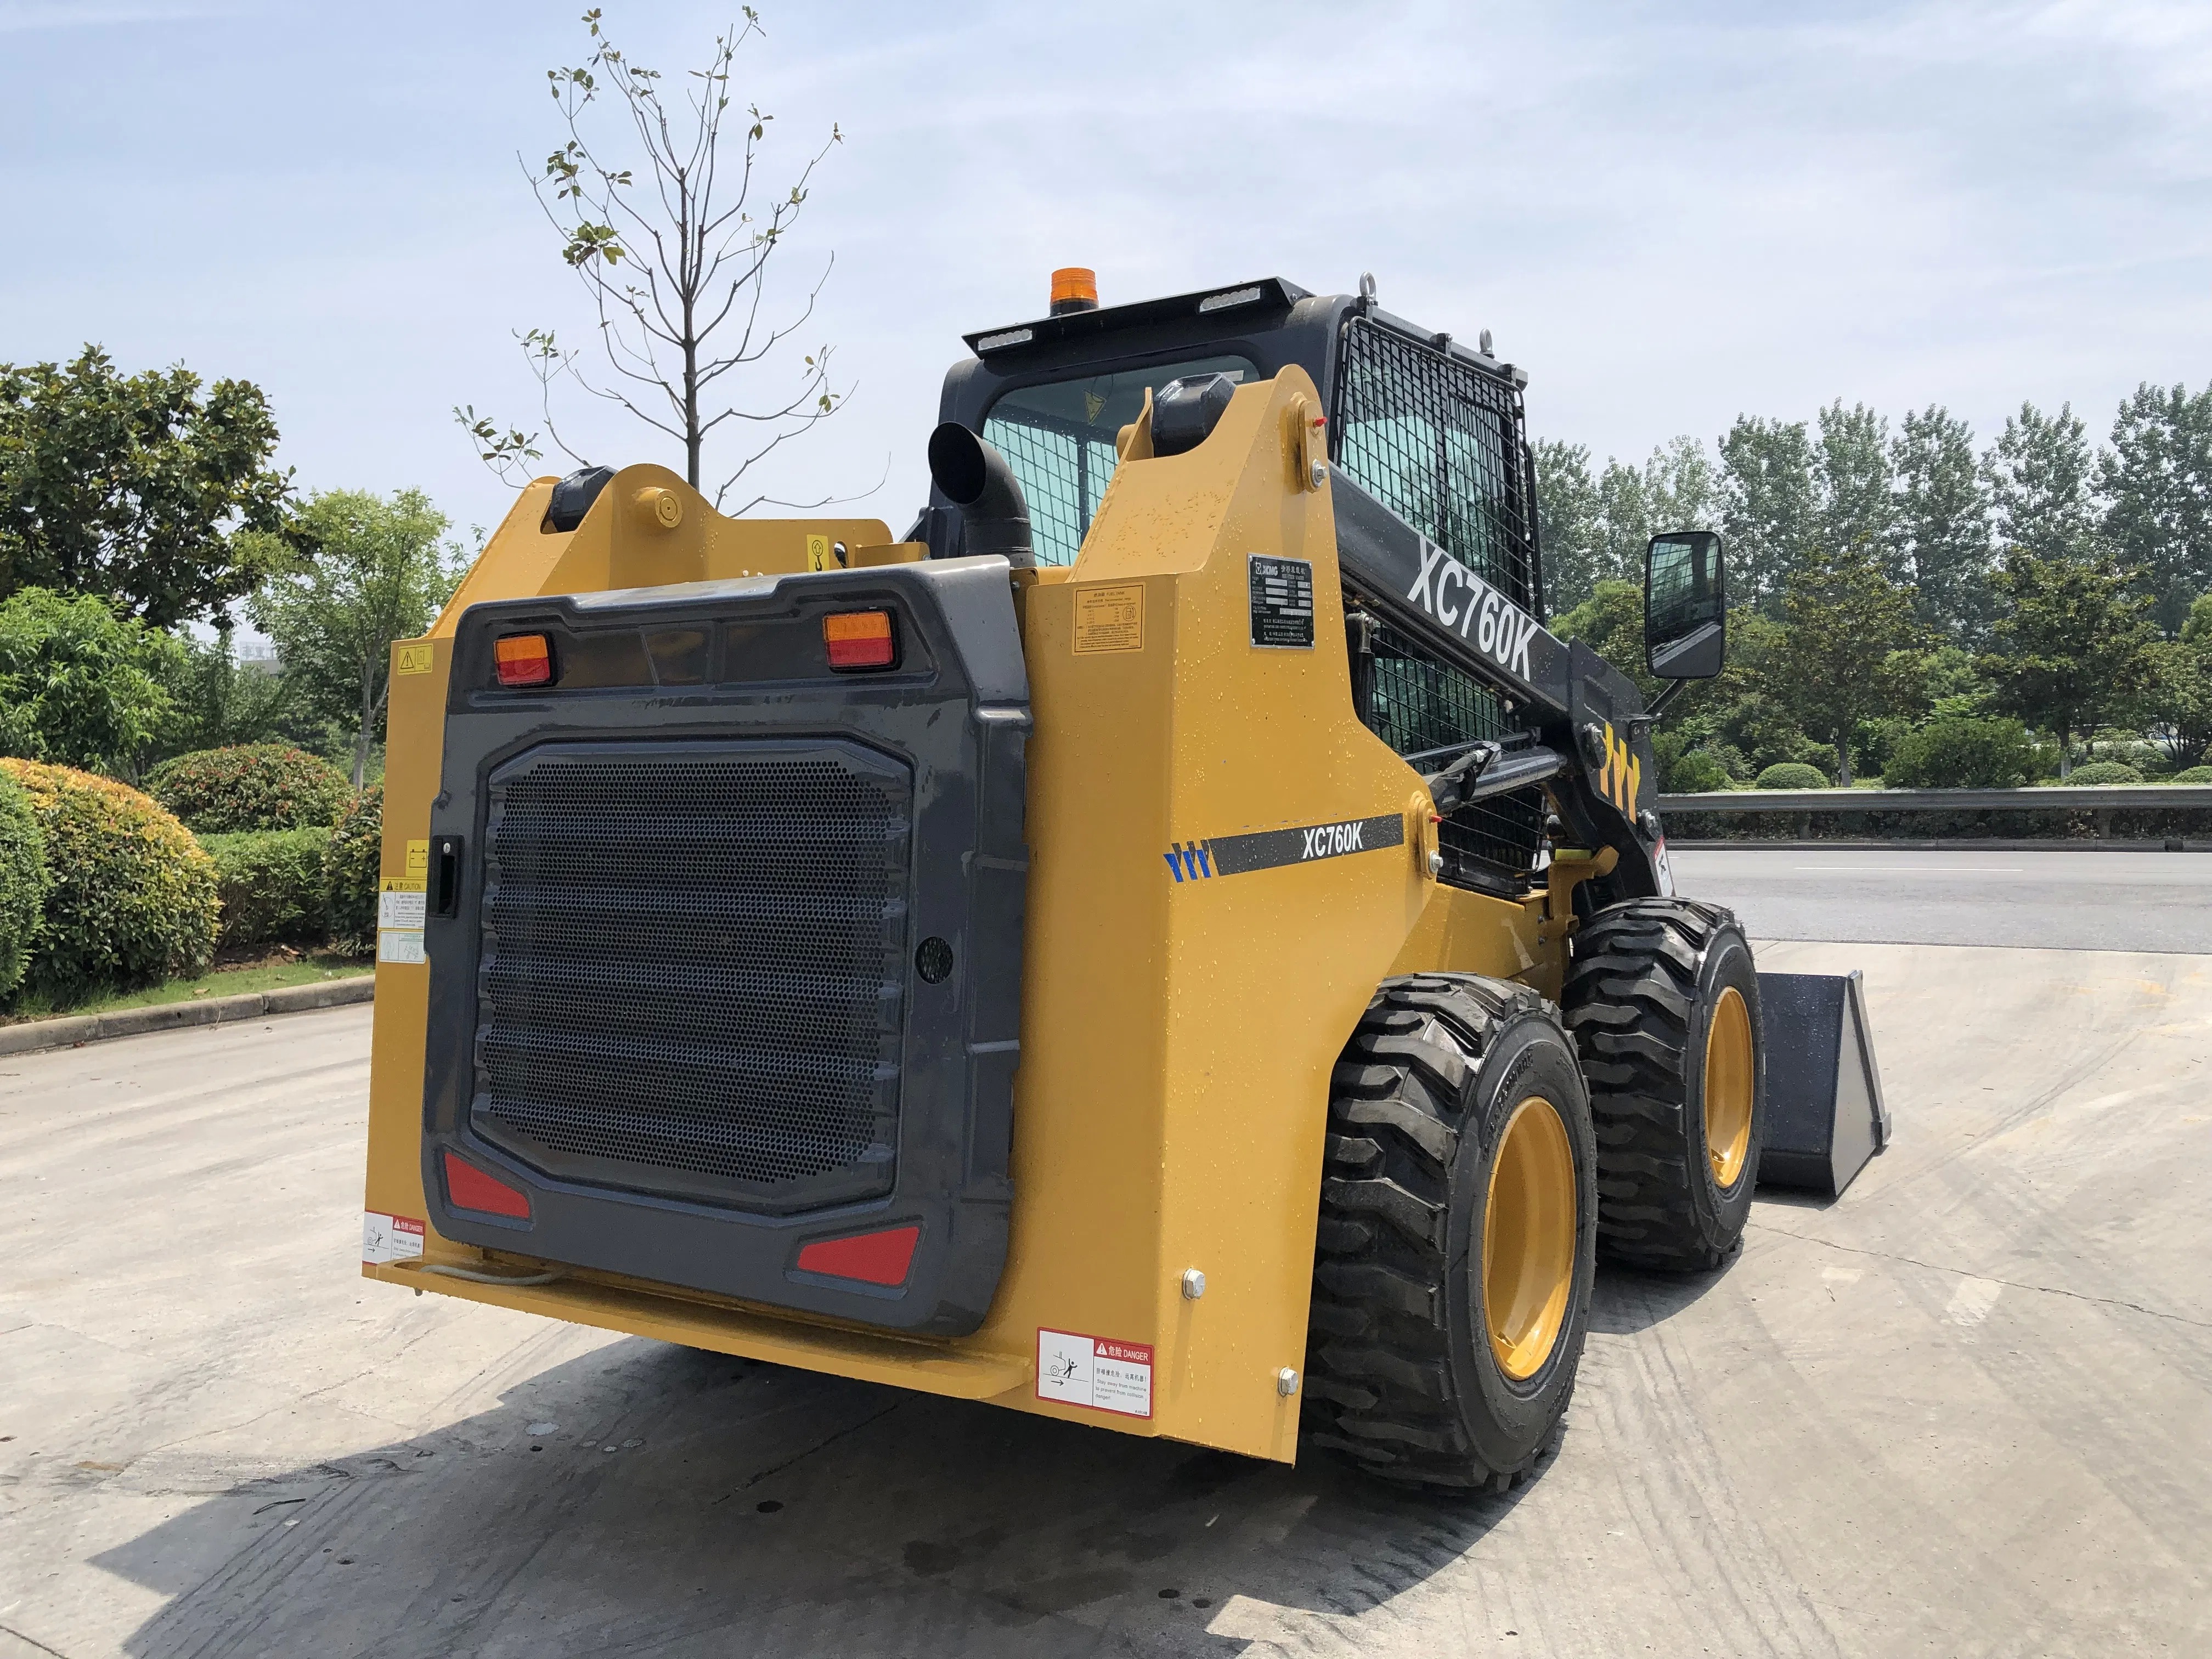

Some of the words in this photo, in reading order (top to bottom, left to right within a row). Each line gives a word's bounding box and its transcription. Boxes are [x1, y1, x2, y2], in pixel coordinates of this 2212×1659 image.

[1407, 536, 1538, 682] XC760K
[1302, 821, 1364, 859] XC760K
[1108, 1345, 1122, 1357] 危险
[1123, 1349, 1148, 1361] DANGER
